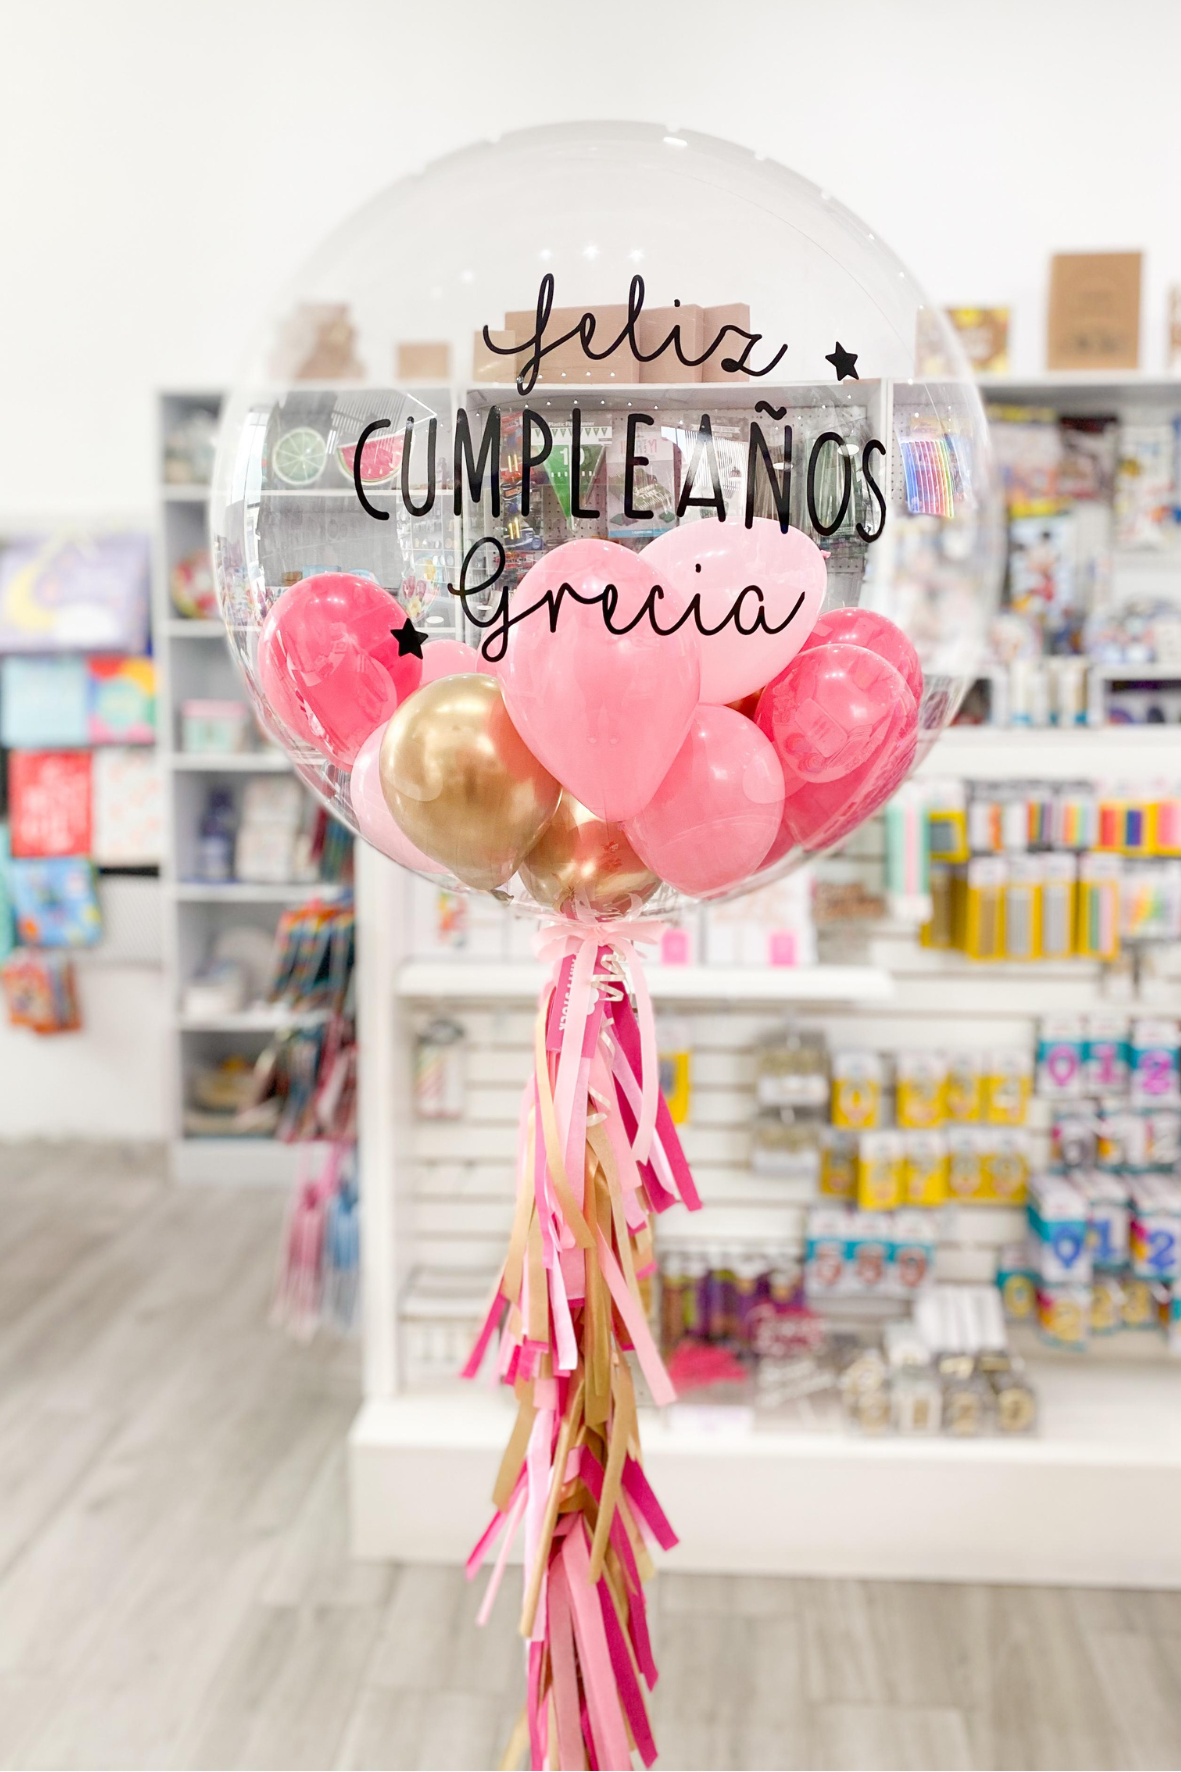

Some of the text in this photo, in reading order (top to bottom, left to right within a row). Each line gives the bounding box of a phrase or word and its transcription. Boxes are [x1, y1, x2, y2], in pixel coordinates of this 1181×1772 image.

[482, 272, 788, 396] feliz
[353, 401, 887, 543] CUMPLEAÑOS
[447, 536, 806, 663] Grecia
